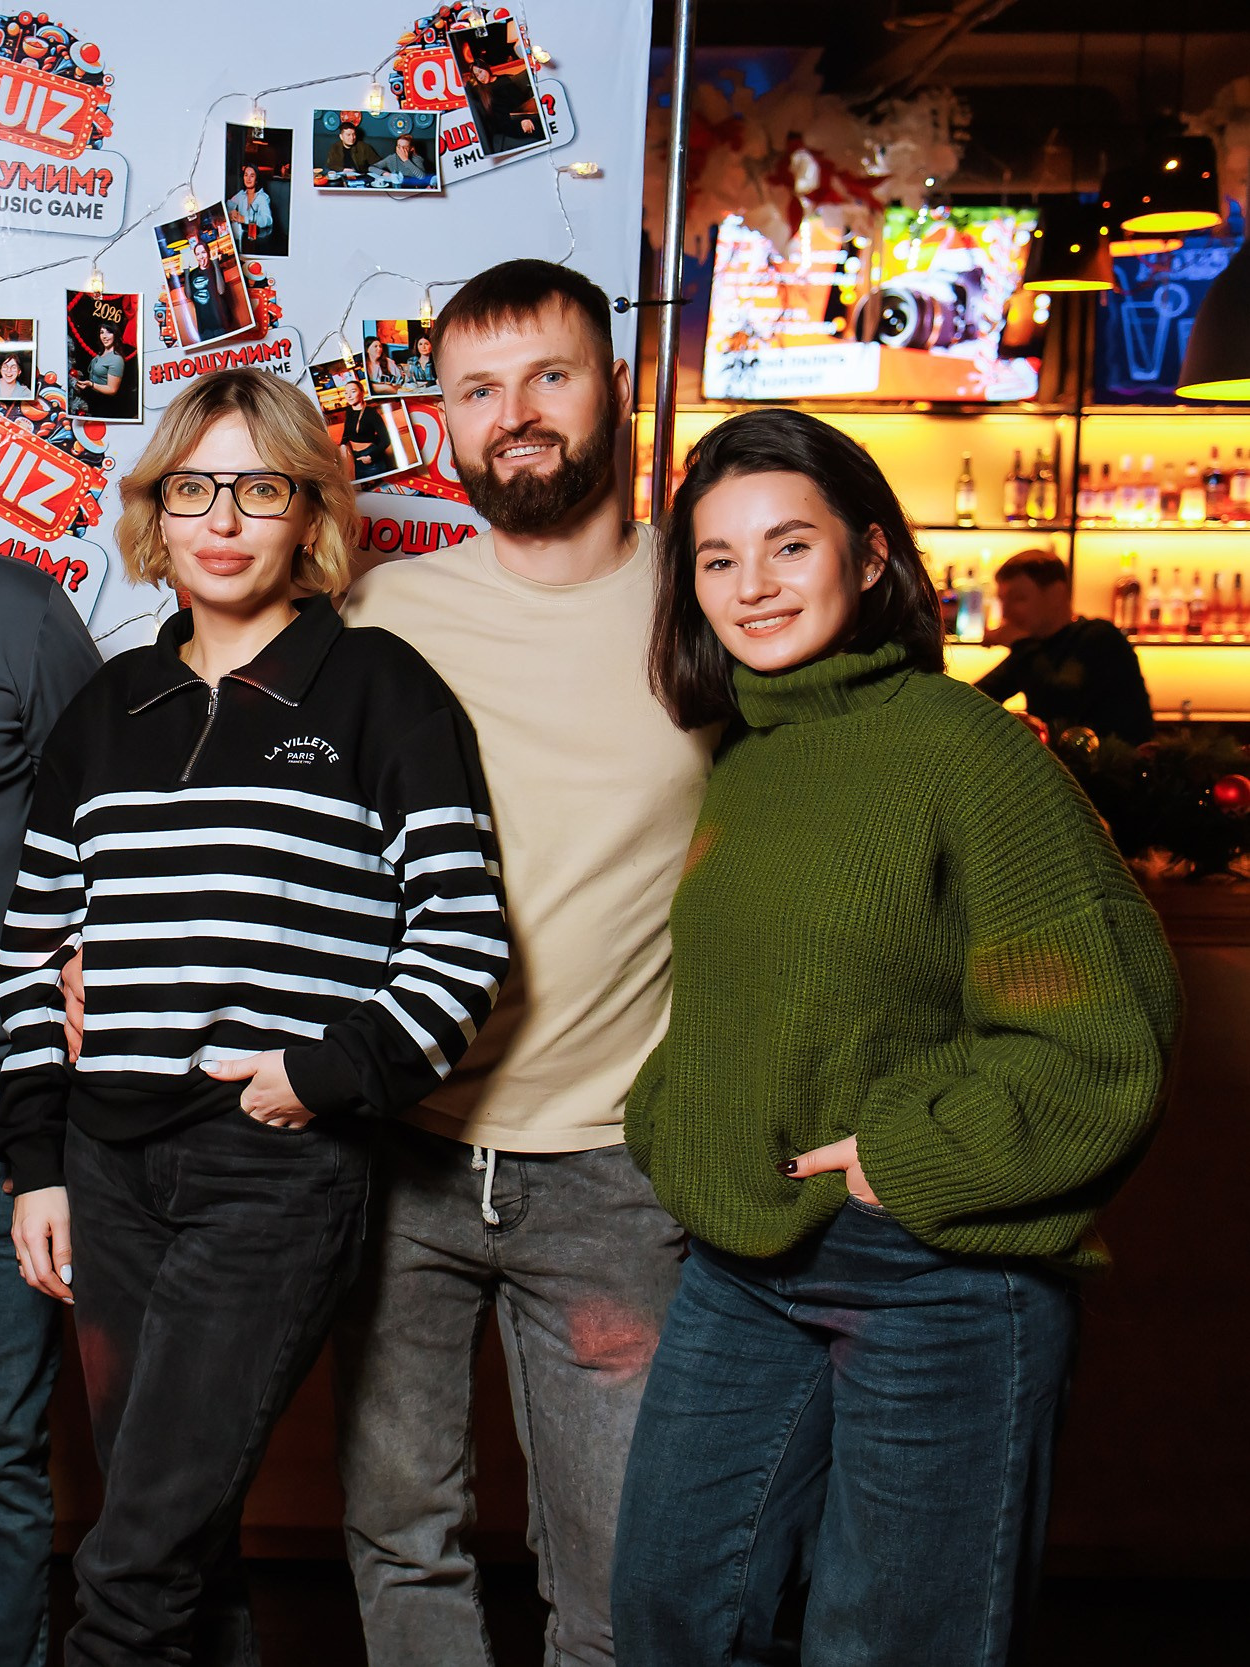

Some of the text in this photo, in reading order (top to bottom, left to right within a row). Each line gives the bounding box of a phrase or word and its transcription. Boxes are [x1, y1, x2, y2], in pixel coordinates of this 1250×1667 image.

[48, 199, 104, 220] GAME
[92, 300, 123, 323] 2026
[149, 338, 292, 384] #ПОШУМИМ?
[264, 736, 340, 763] LA VILLETTE
[287, 752, 315, 761] PARIS
